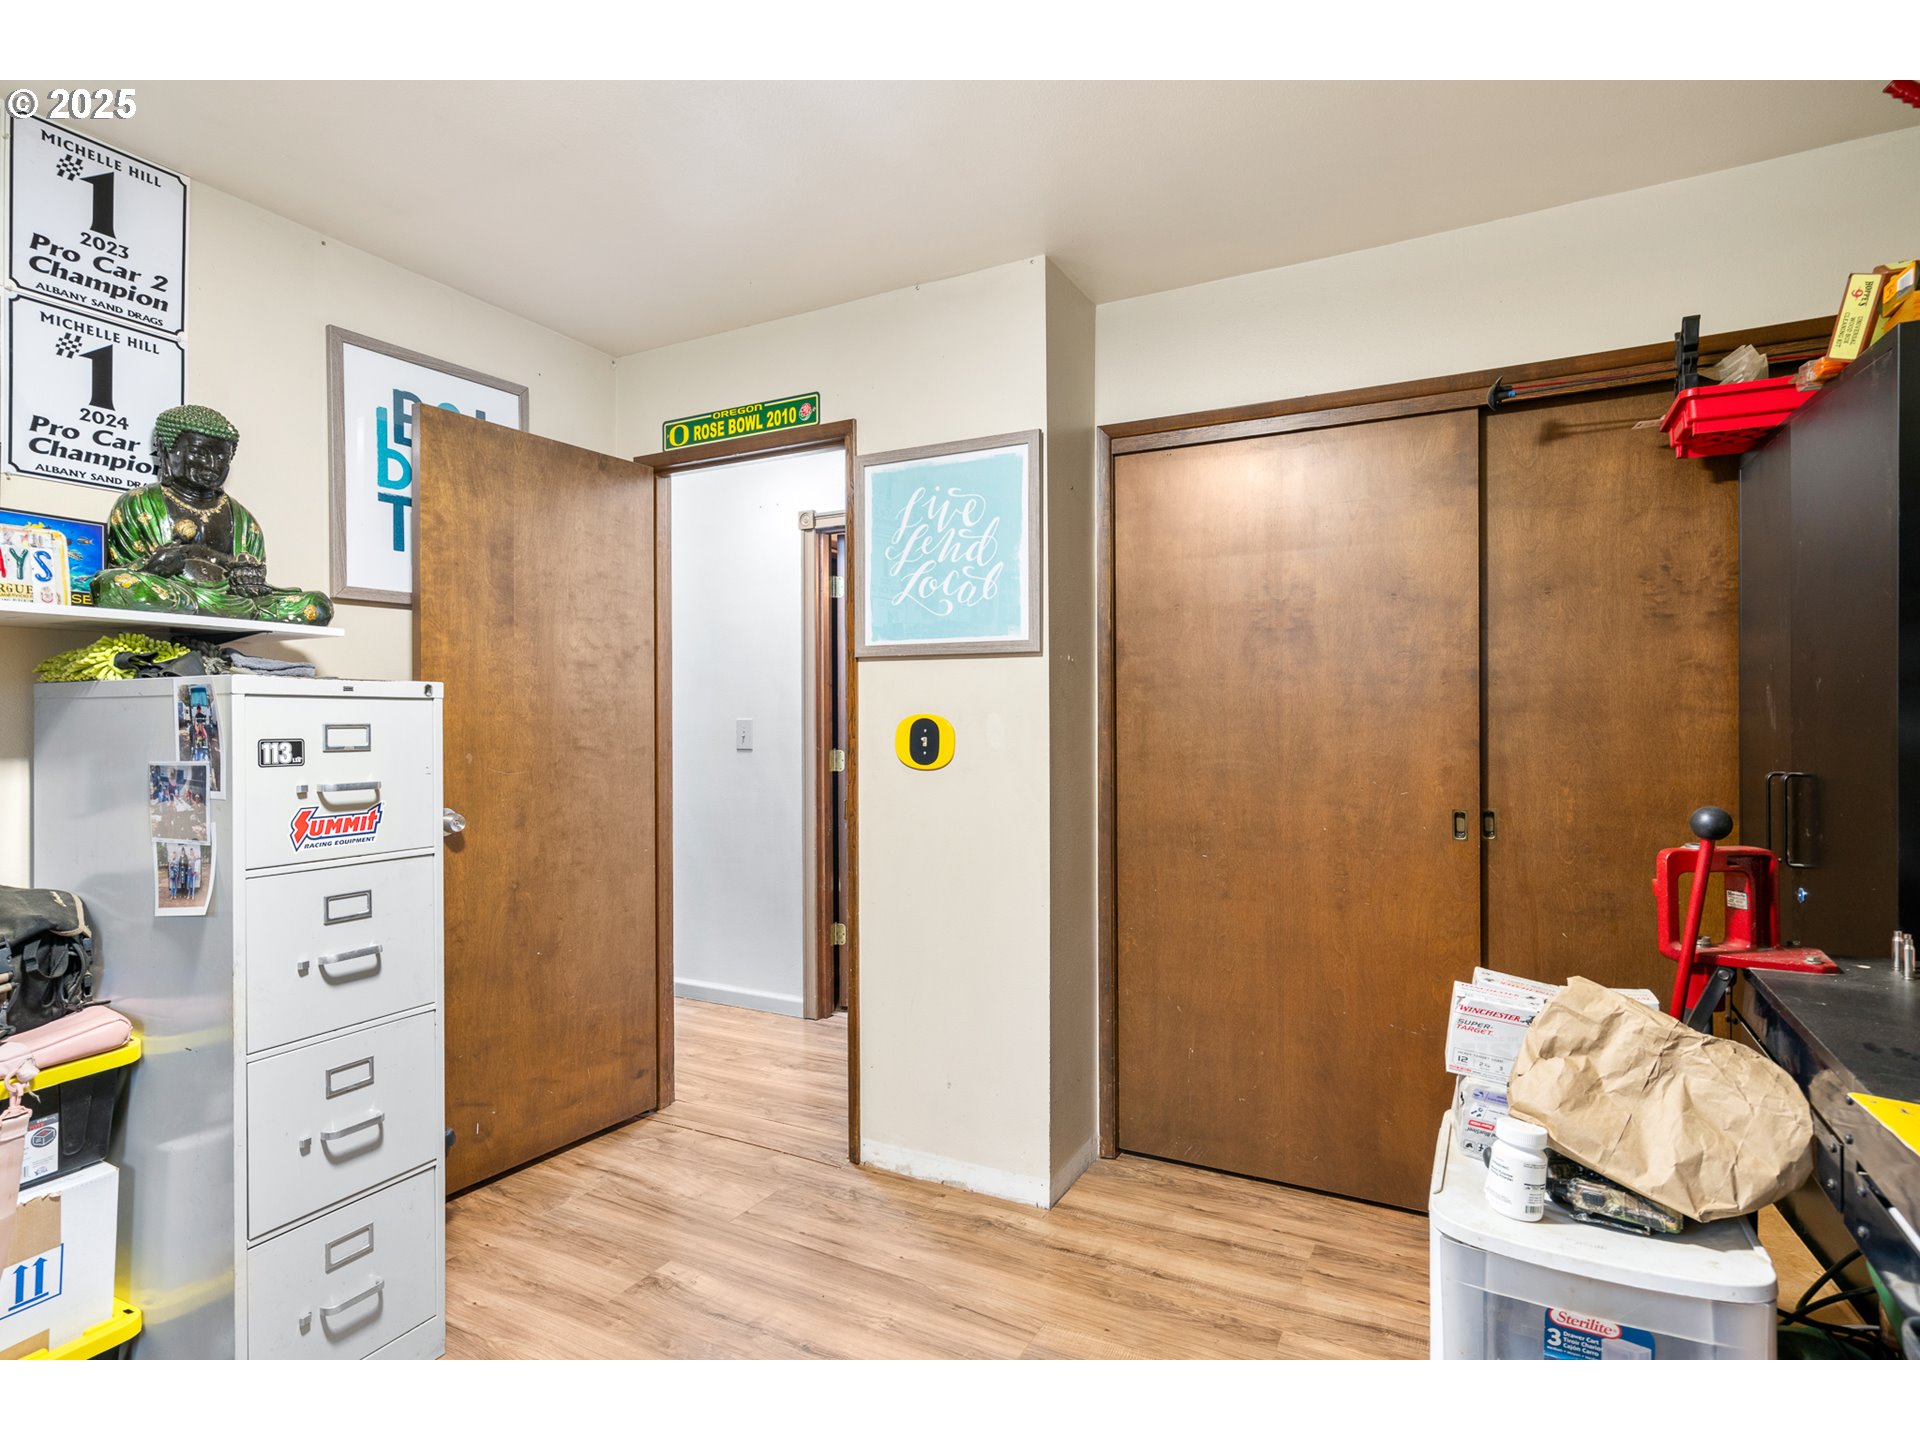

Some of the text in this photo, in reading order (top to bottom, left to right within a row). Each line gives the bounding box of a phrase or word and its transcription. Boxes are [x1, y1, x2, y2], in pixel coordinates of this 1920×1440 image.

[40, 128, 162, 188] MICHELLE HILL
[79, 231, 130, 260] 2023
[29, 232, 169, 293] Pro Car 2
[28, 255, 169, 313] Champion
[35, 281, 164, 327] ALBANY SAND DRAGS
[39, 310, 160, 355] MICHELLE HILL
[79, 408, 129, 430] 2024
[693, 420, 725, 441] ROSE
[728, 414, 763, 435] BOWL
[766, 407, 797, 427] 2010
[712, 403, 763, 420] OREGON
[28, 414, 141, 452] Pro Car
[34, 463, 87, 479] ALBANY
[90, 473, 123, 485] SAND
[891, 486, 986, 545] Live
[885, 516, 1001, 577] Lend
[891, 559, 1004, 617] Local
[261, 742, 292, 765] 113
[303, 836, 376, 849] RACING EQUIPMENT
[1458, 1004, 1521, 1022] WINCHESTER
[1457, 1055, 1469, 1064] 12
[1547, 1327, 1562, 1346] 3
[1557, 1311, 1613, 1335] Sterilite
[1563, 1331, 1600, 1346] Drawer Cart
